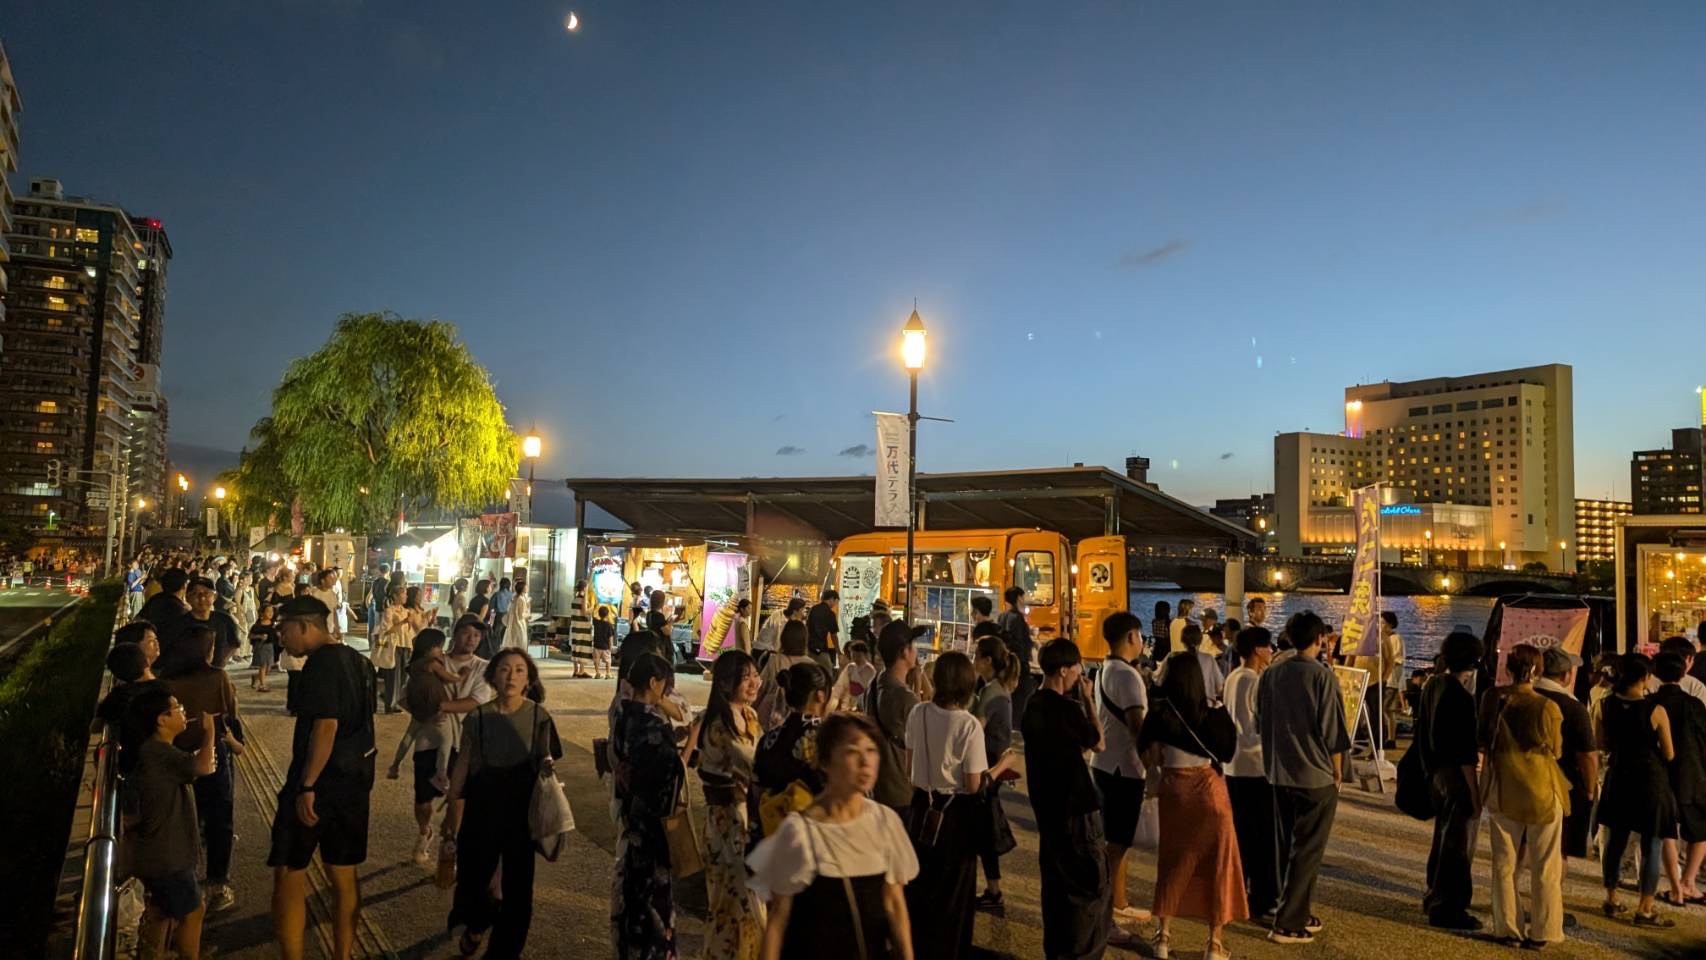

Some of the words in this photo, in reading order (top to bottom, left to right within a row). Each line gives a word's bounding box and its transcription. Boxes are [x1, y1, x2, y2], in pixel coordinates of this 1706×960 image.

[886, 445, 899, 514] 万代テラス
